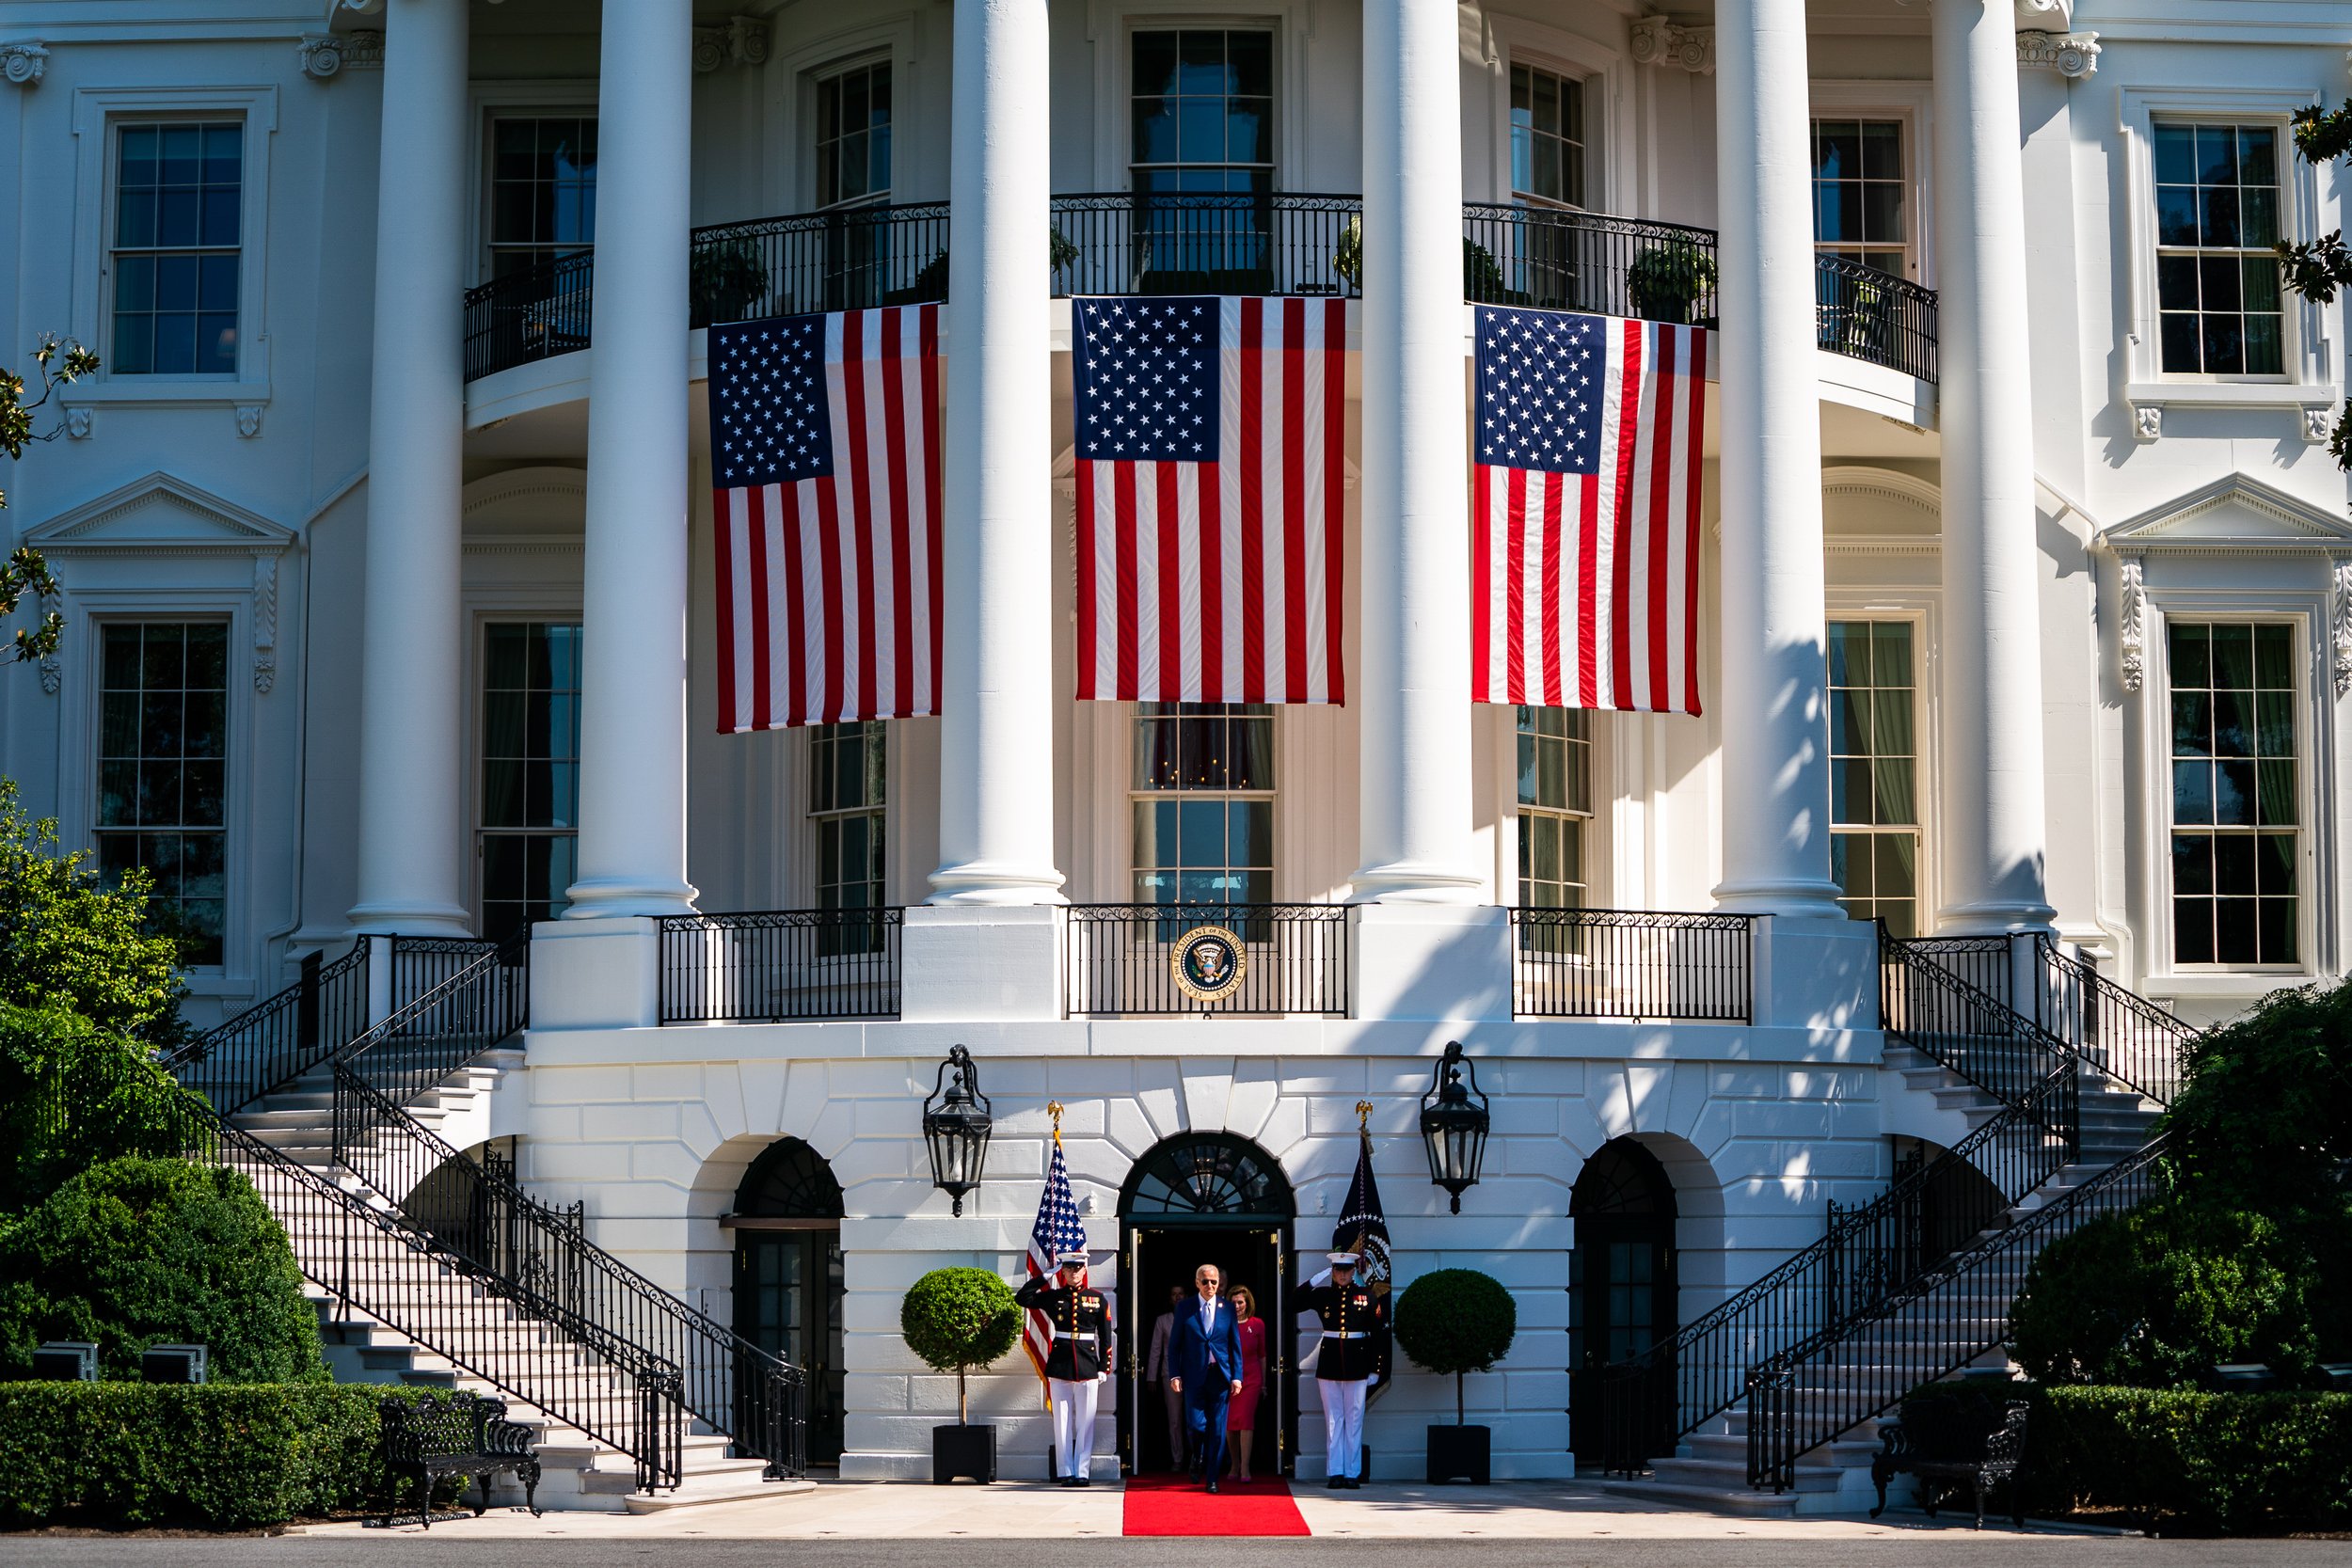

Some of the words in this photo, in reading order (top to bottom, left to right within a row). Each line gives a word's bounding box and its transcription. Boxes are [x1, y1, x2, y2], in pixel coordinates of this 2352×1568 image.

[1173, 927, 1207, 962] PRESIDENT
[1229, 937, 1246, 969] UNITED
[1184, 985, 1202, 998] SEAL
[1216, 974, 1242, 997] STATES
